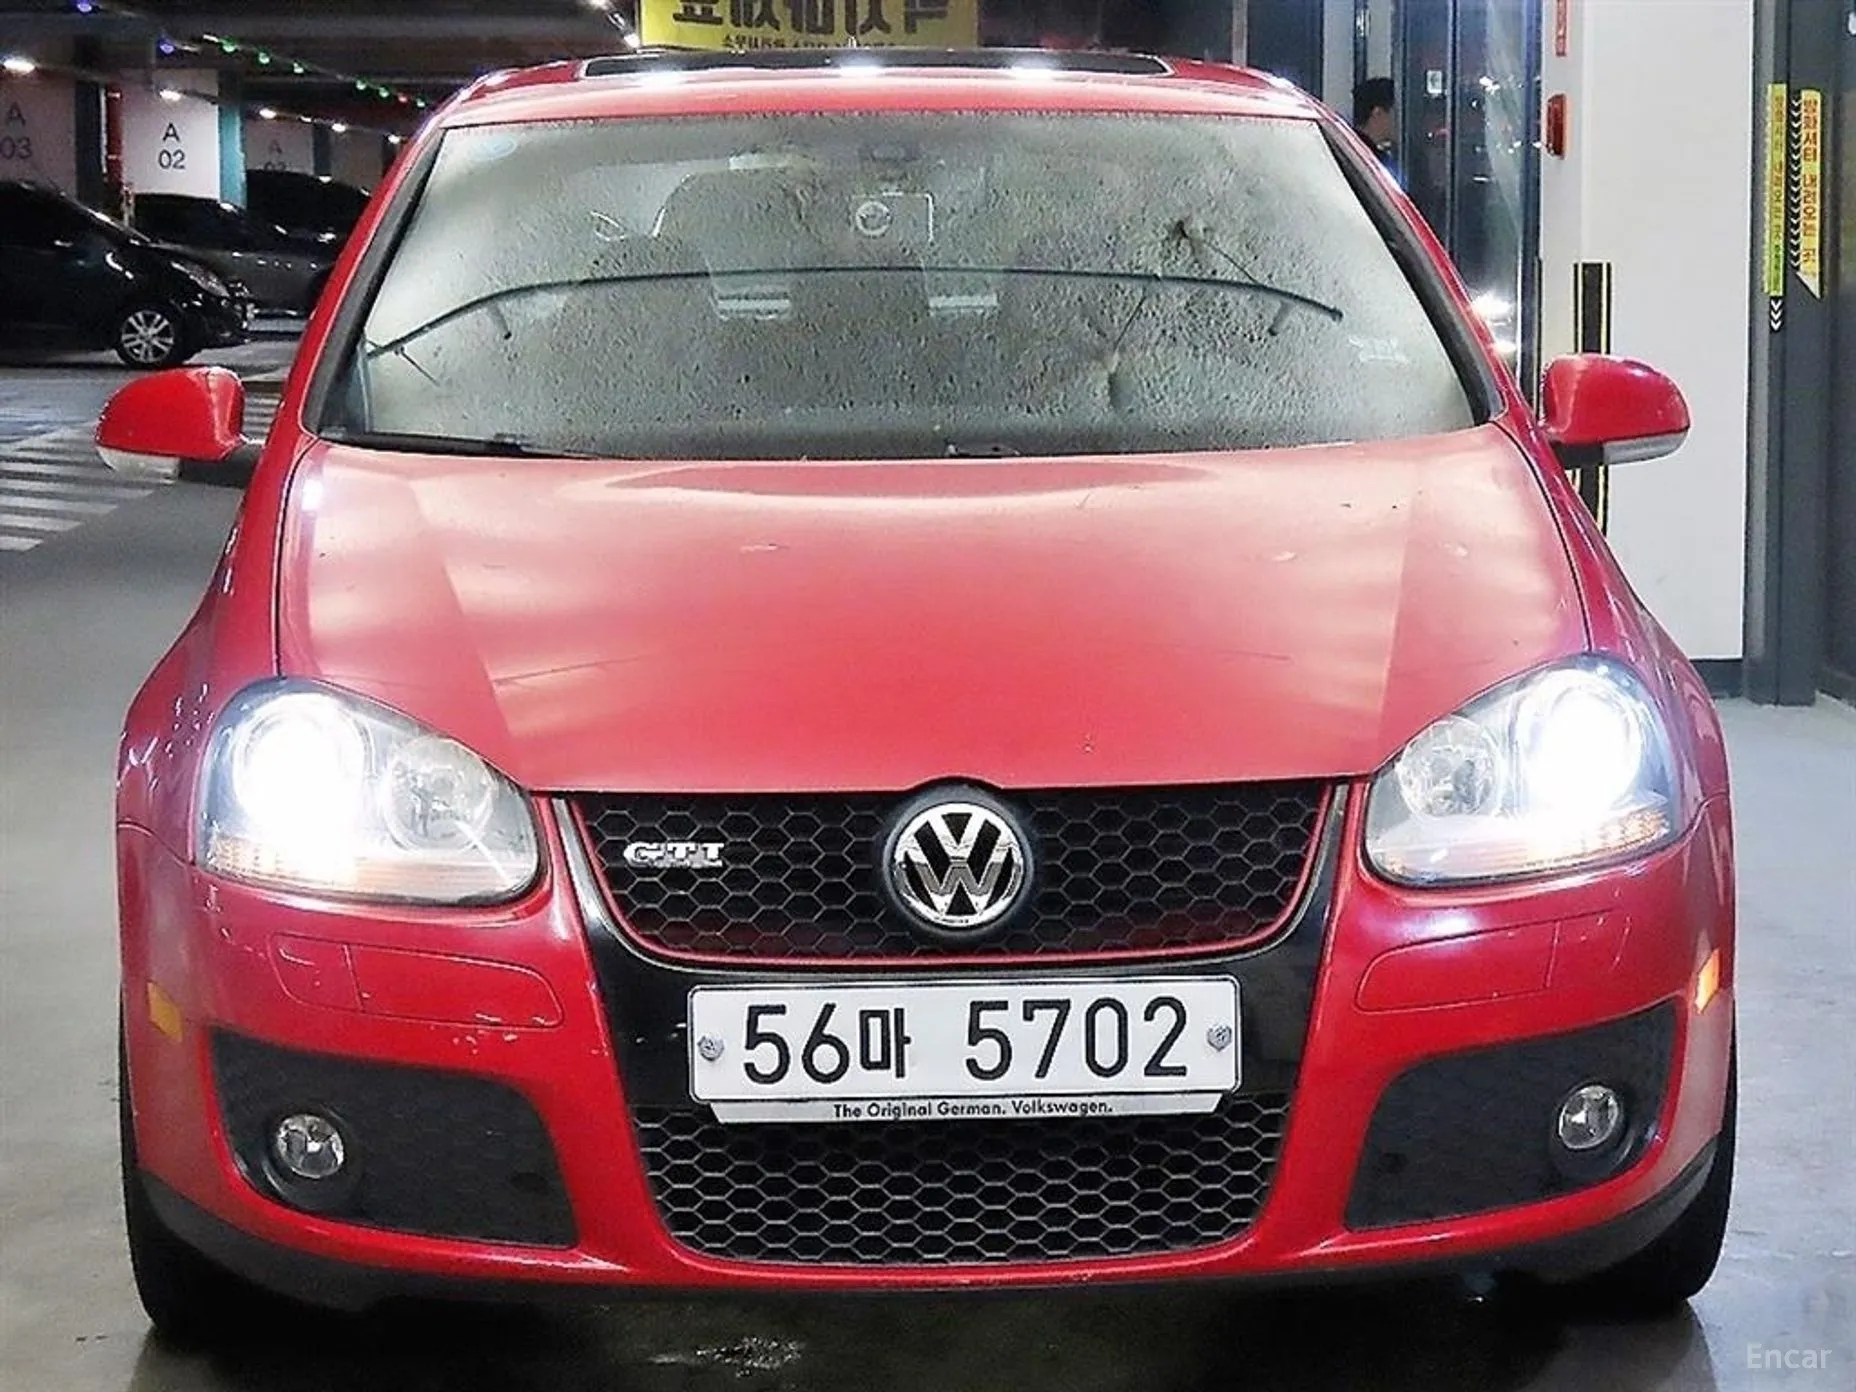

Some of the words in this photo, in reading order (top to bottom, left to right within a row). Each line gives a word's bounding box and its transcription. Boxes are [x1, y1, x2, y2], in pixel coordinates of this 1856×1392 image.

[6, 101, 26, 125] A
[162, 121, 180, 142] A
[0, 136, 33, 160] 03
[158, 149, 186, 170] 02
[623, 841, 725, 869] GTI
[743, 1002, 912, 1085] 56마
[965, 996, 1188, 1081] 5702
[833, 1103, 862, 1118] The
[867, 1102, 932, 1121] Original
[936, 1101, 1007, 1116] German.
[1011, 1099, 1114, 1117] Volkswagen.
